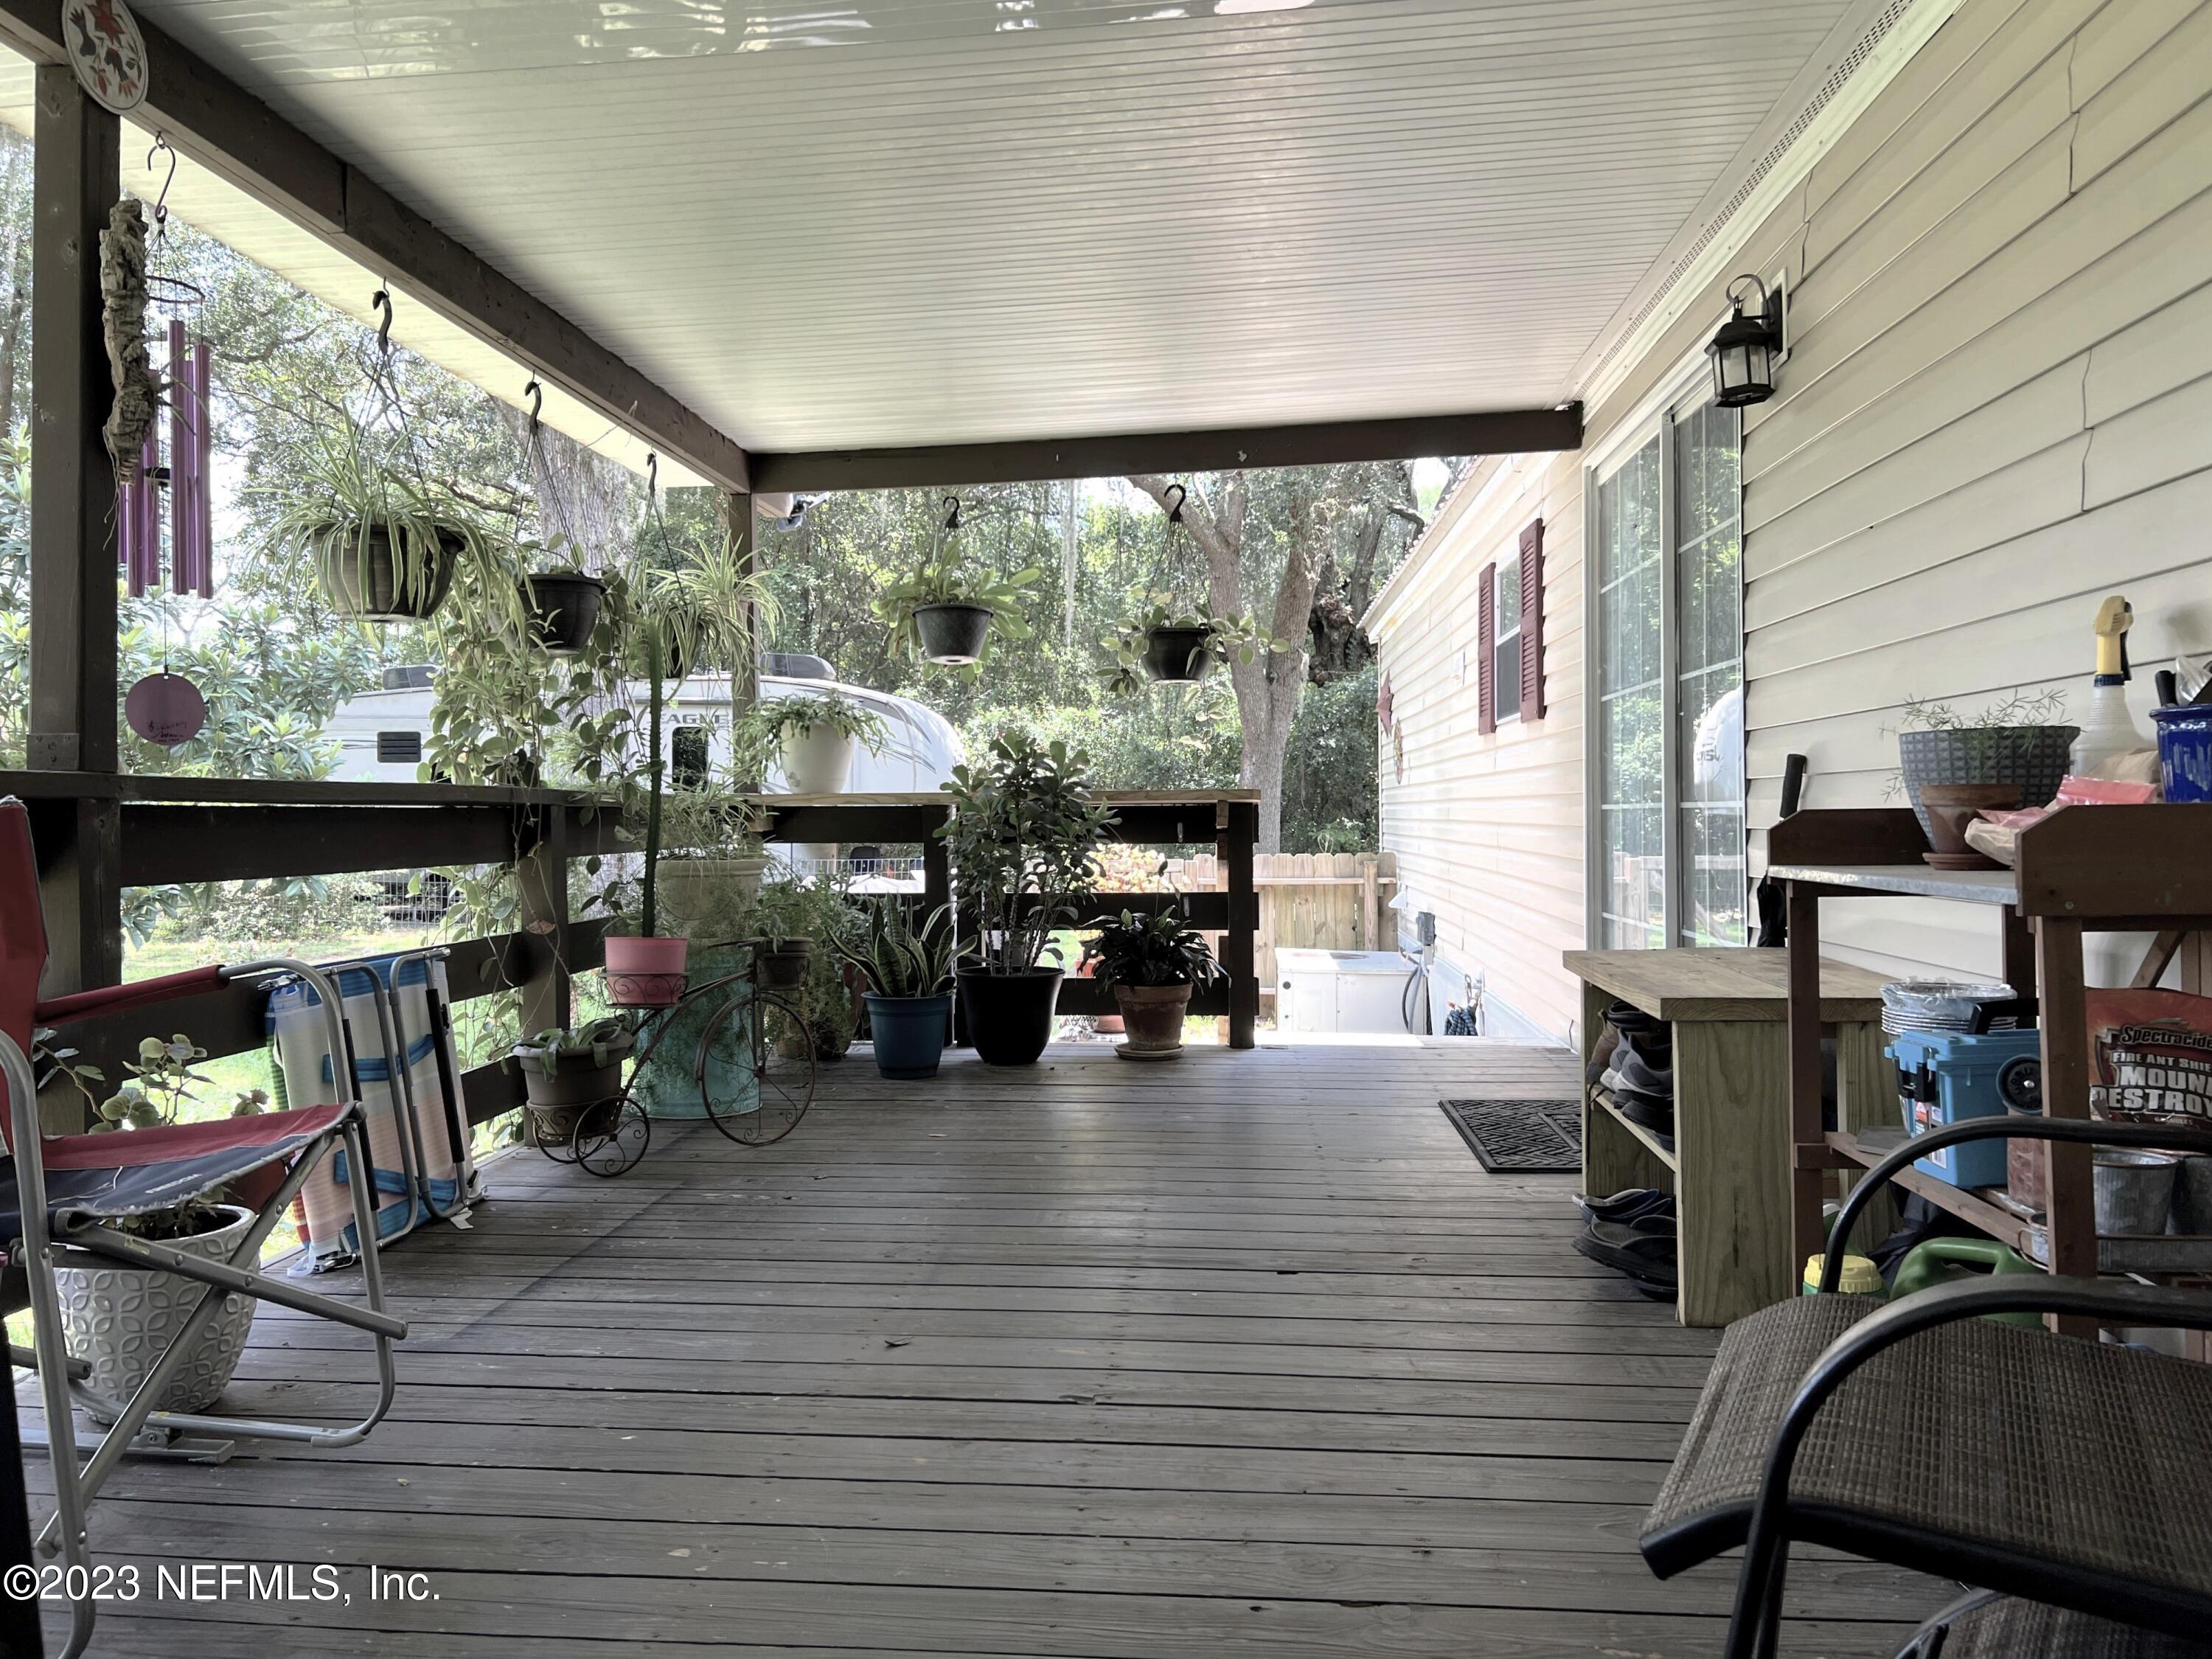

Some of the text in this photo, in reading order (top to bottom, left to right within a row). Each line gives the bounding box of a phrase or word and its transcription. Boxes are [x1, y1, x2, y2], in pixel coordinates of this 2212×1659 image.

[658, 714, 730, 723] AGE
[2121, 1026, 2212, 1048] Spectracide
[2112, 1051, 2142, 1062] FIRE
[2146, 1054, 2174, 1066] ANT
